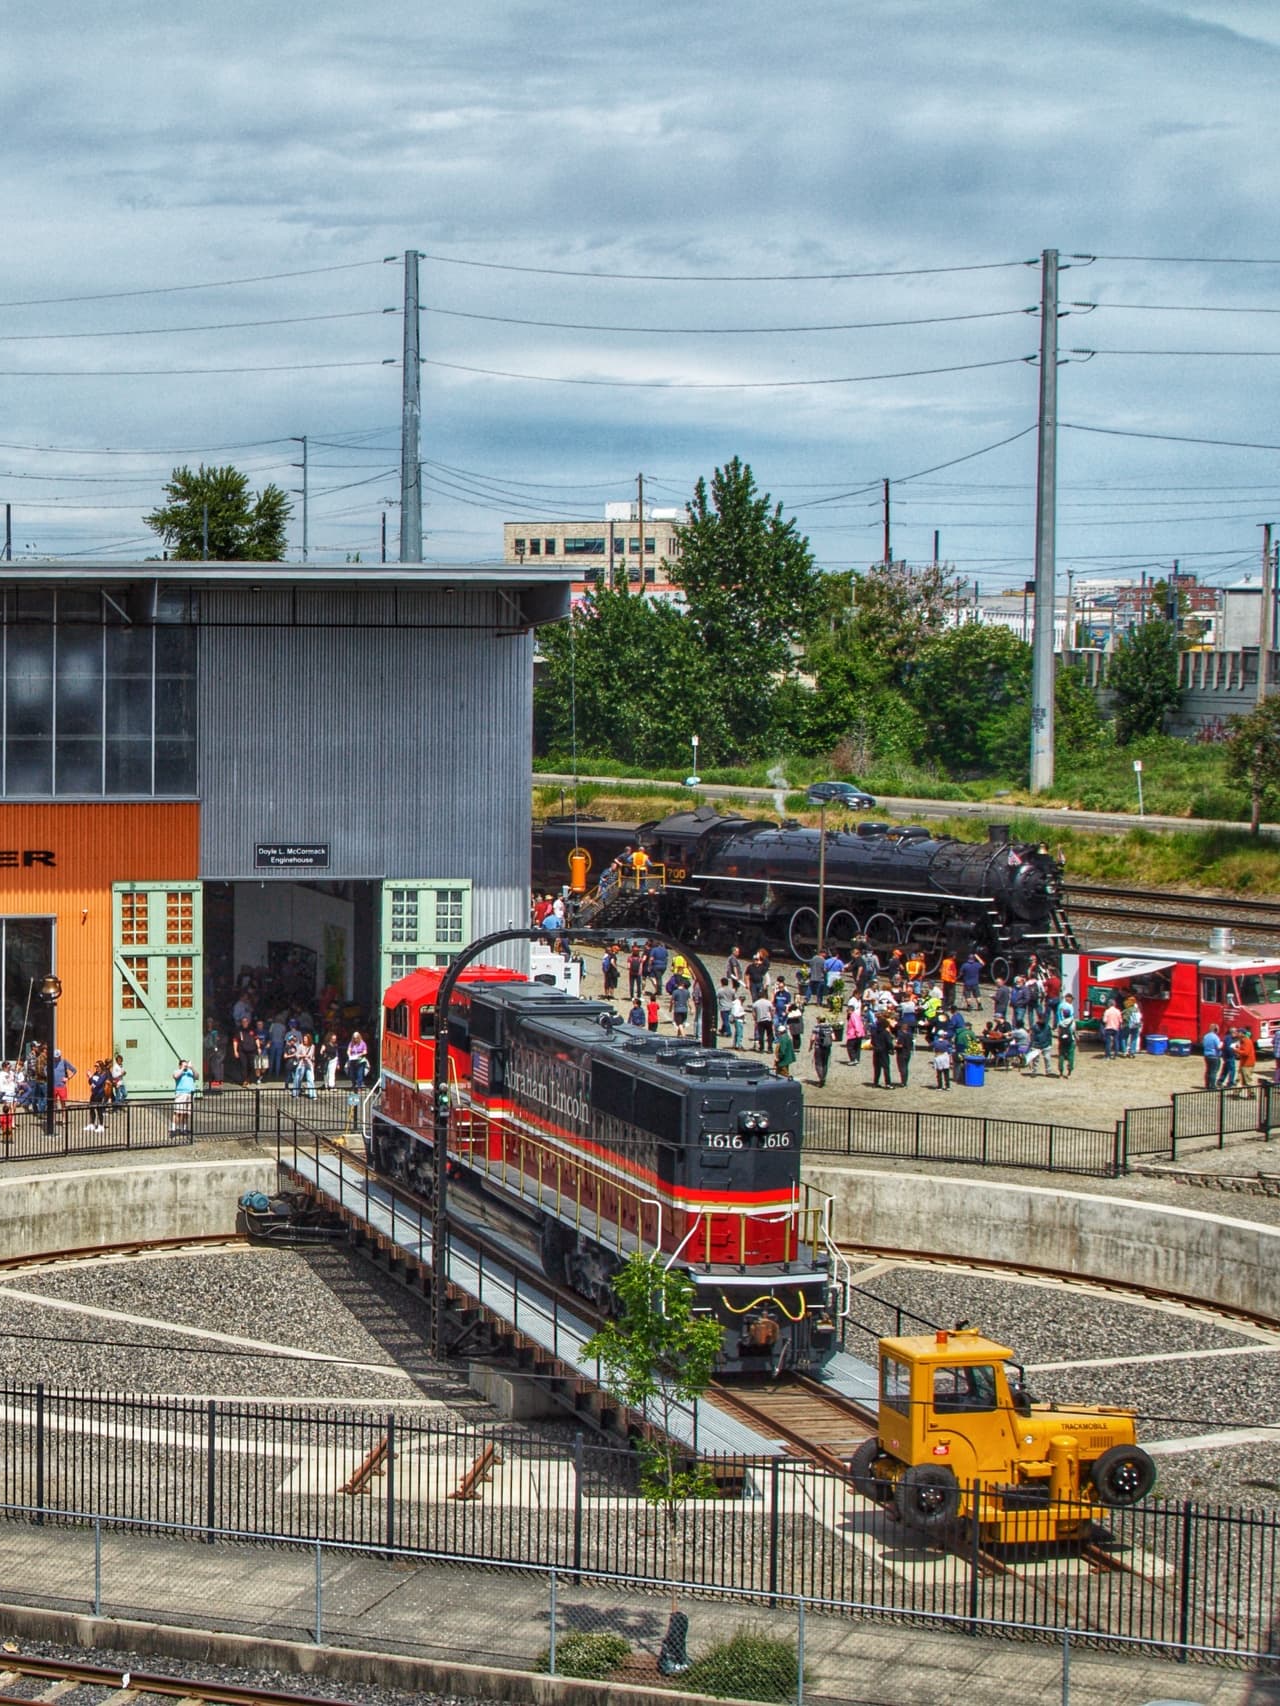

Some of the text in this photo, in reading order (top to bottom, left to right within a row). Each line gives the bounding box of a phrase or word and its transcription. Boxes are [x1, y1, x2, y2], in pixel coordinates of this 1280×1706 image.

[258, 848, 277, 856] Doyle
[504, 1060, 590, 1125] Abraham Lincoln
[706, 1134, 744, 1149] 1616
[763, 1132, 790, 1149] 1616
[1061, 1423, 1108, 1431] TRACKMOBILE
